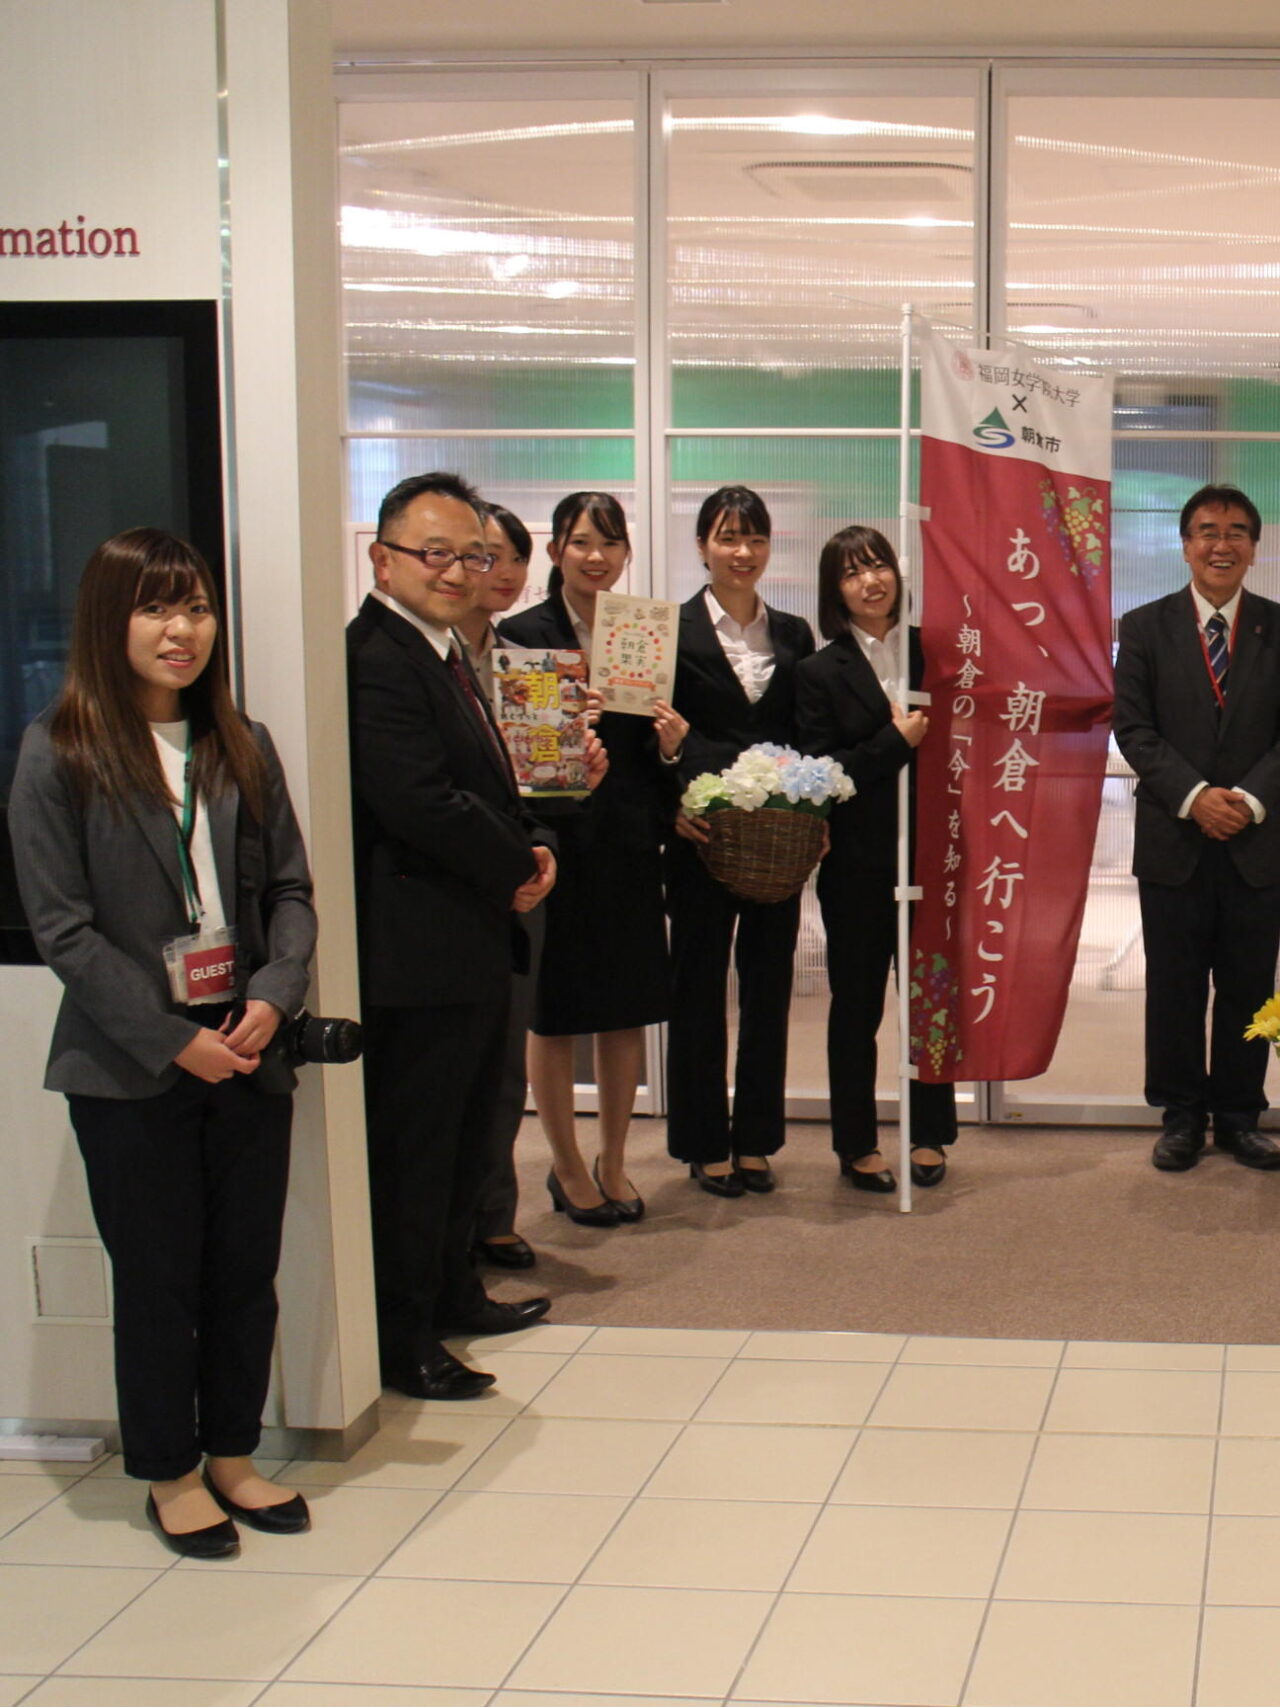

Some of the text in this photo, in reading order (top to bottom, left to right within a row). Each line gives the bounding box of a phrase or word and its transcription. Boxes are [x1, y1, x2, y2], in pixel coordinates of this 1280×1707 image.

[977, 363, 1082, 408] 福岡女学院大学
[190, 960, 235, 981] GUEST
